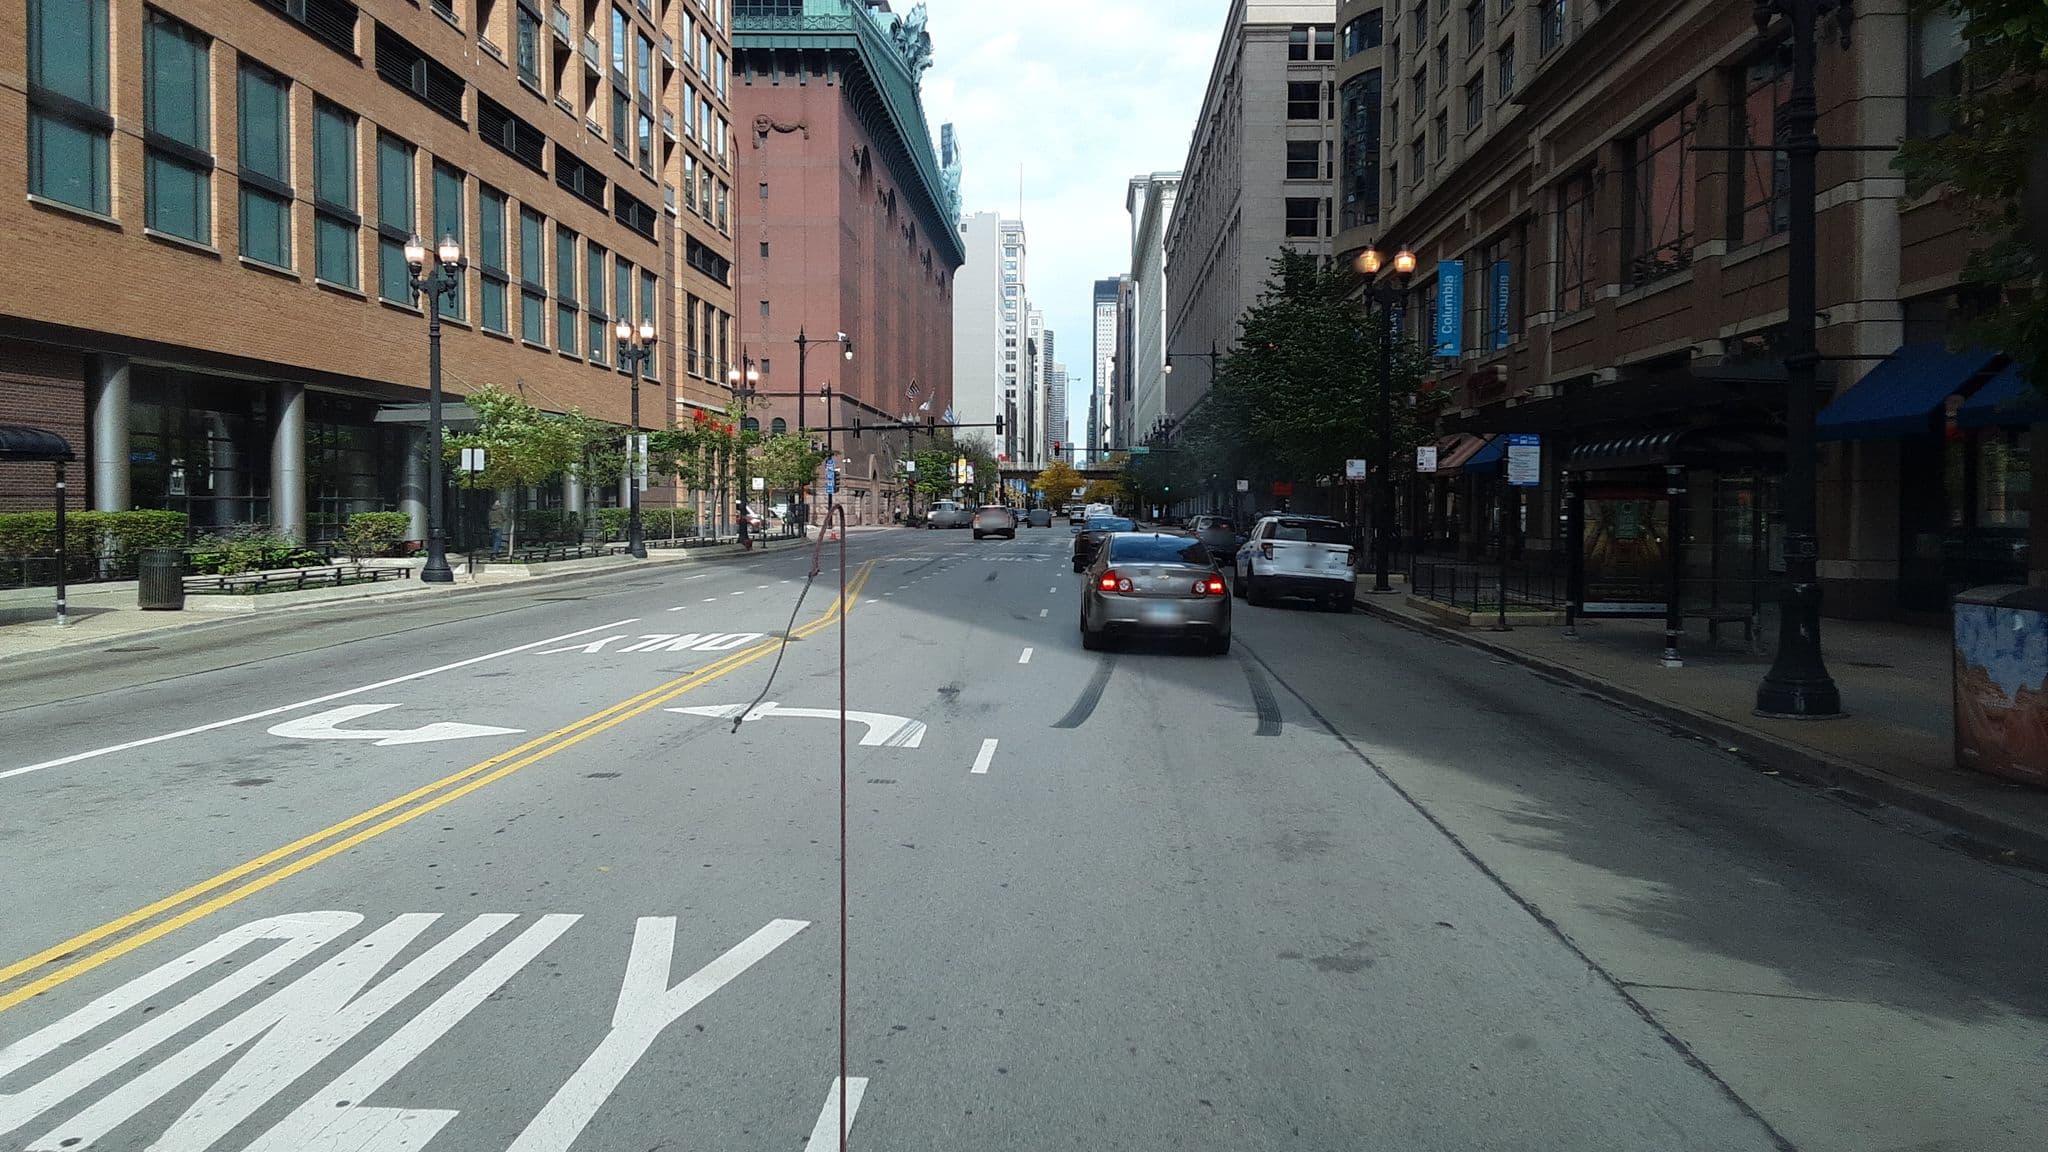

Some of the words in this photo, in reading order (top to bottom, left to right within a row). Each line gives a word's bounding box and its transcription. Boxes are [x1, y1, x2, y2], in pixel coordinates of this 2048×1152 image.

[1441, 275, 1454, 334] Columbia
[536, 632, 764, 656] ONLY
[0, 910, 811, 1152] ONLY
